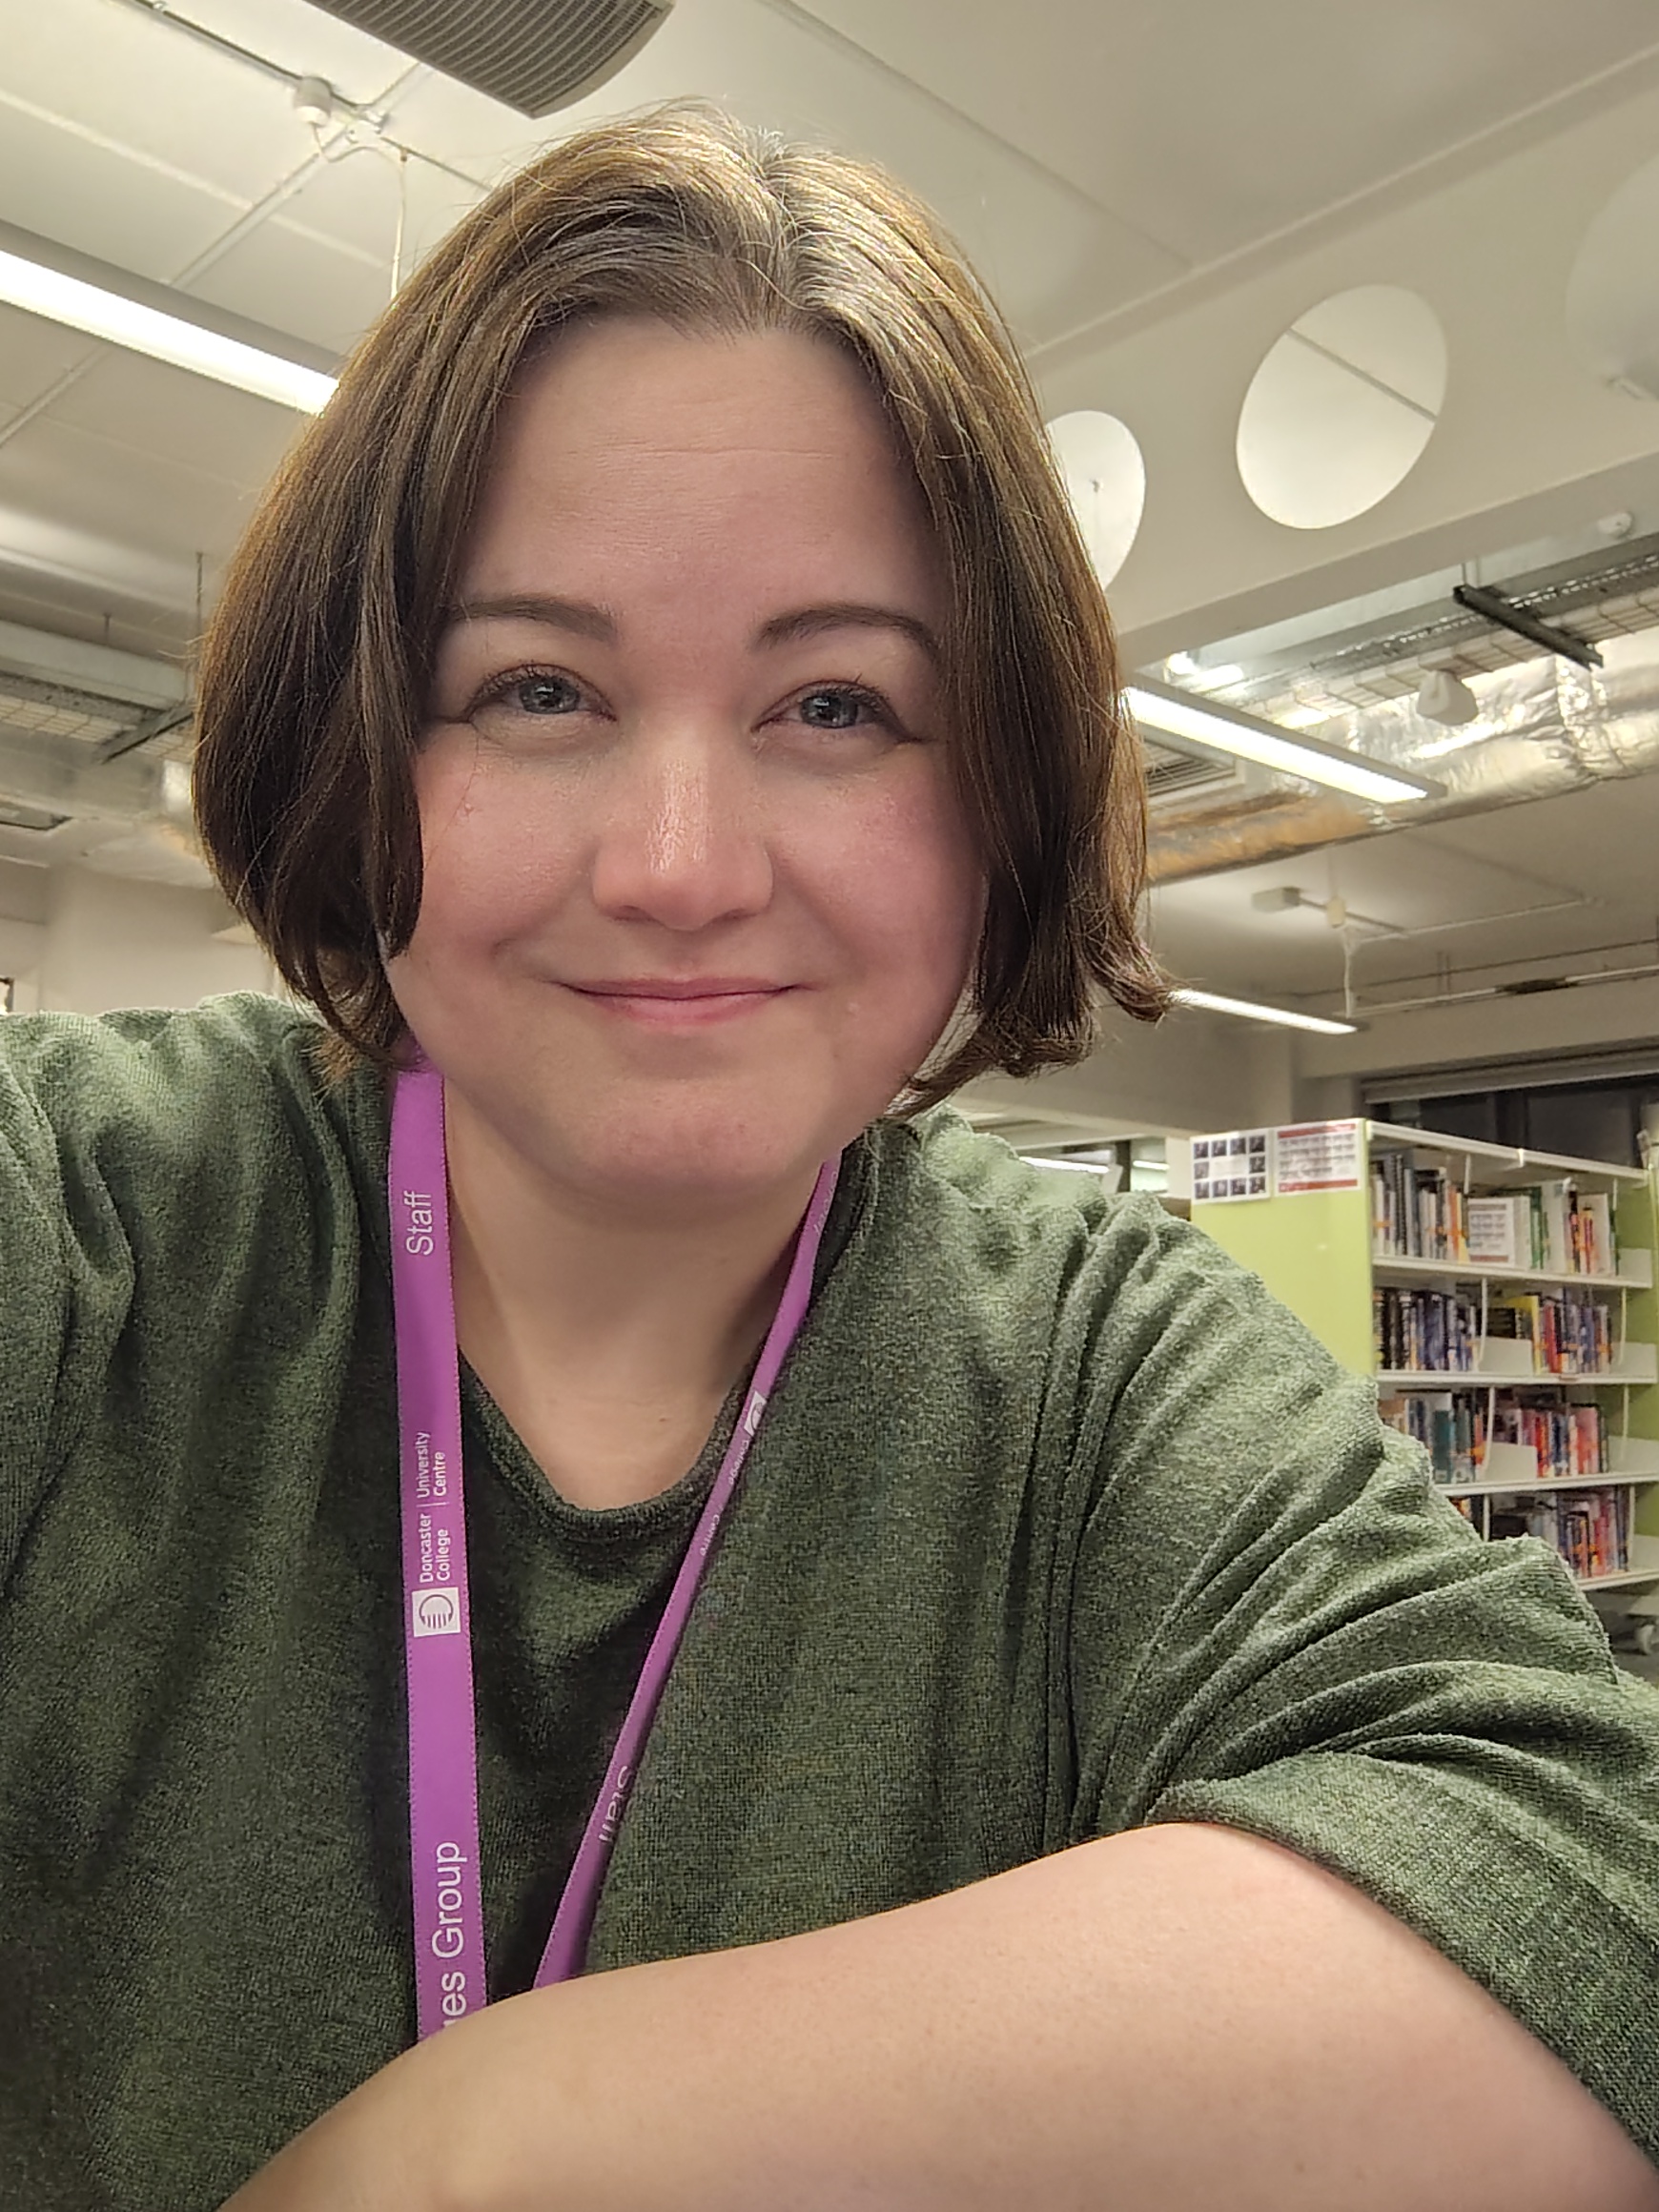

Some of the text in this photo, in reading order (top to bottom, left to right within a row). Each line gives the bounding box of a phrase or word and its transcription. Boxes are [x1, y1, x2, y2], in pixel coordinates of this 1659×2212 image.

[403, 1190, 434, 1256] Staff
[416, 1431, 431, 1499] University
[433, 1451, 447, 1497] Centre
[420, 1513, 434, 1583] Doncaster
[436, 1528, 451, 1582] College
[431, 1841, 468, 2028] es Group
